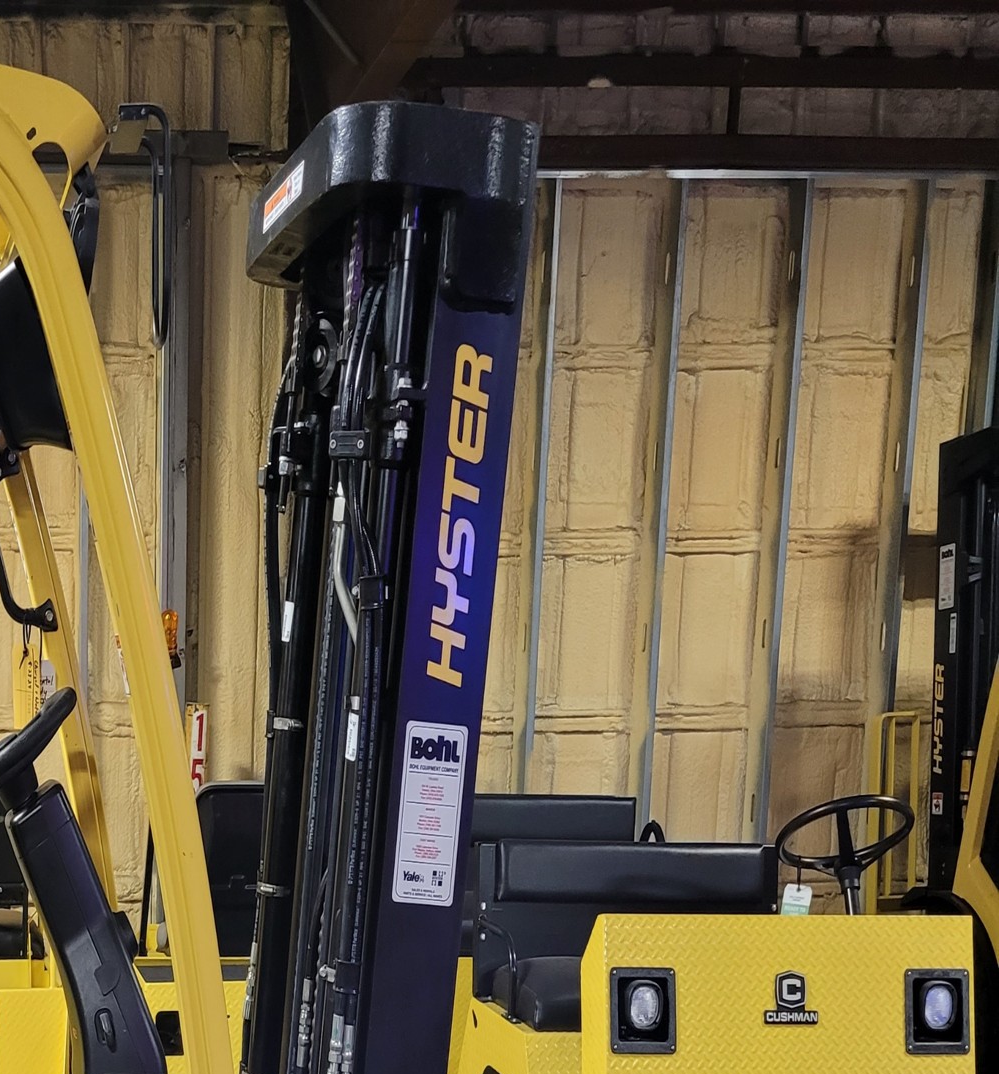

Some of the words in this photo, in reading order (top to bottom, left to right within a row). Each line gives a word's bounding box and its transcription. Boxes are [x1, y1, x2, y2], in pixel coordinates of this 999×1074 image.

[426, 343, 493, 688] HYSTER
[932, 663, 945, 775] HYSTER
[403, 870, 420, 883] Yale
[766, 1012, 818, 1023] CUSHMAN
